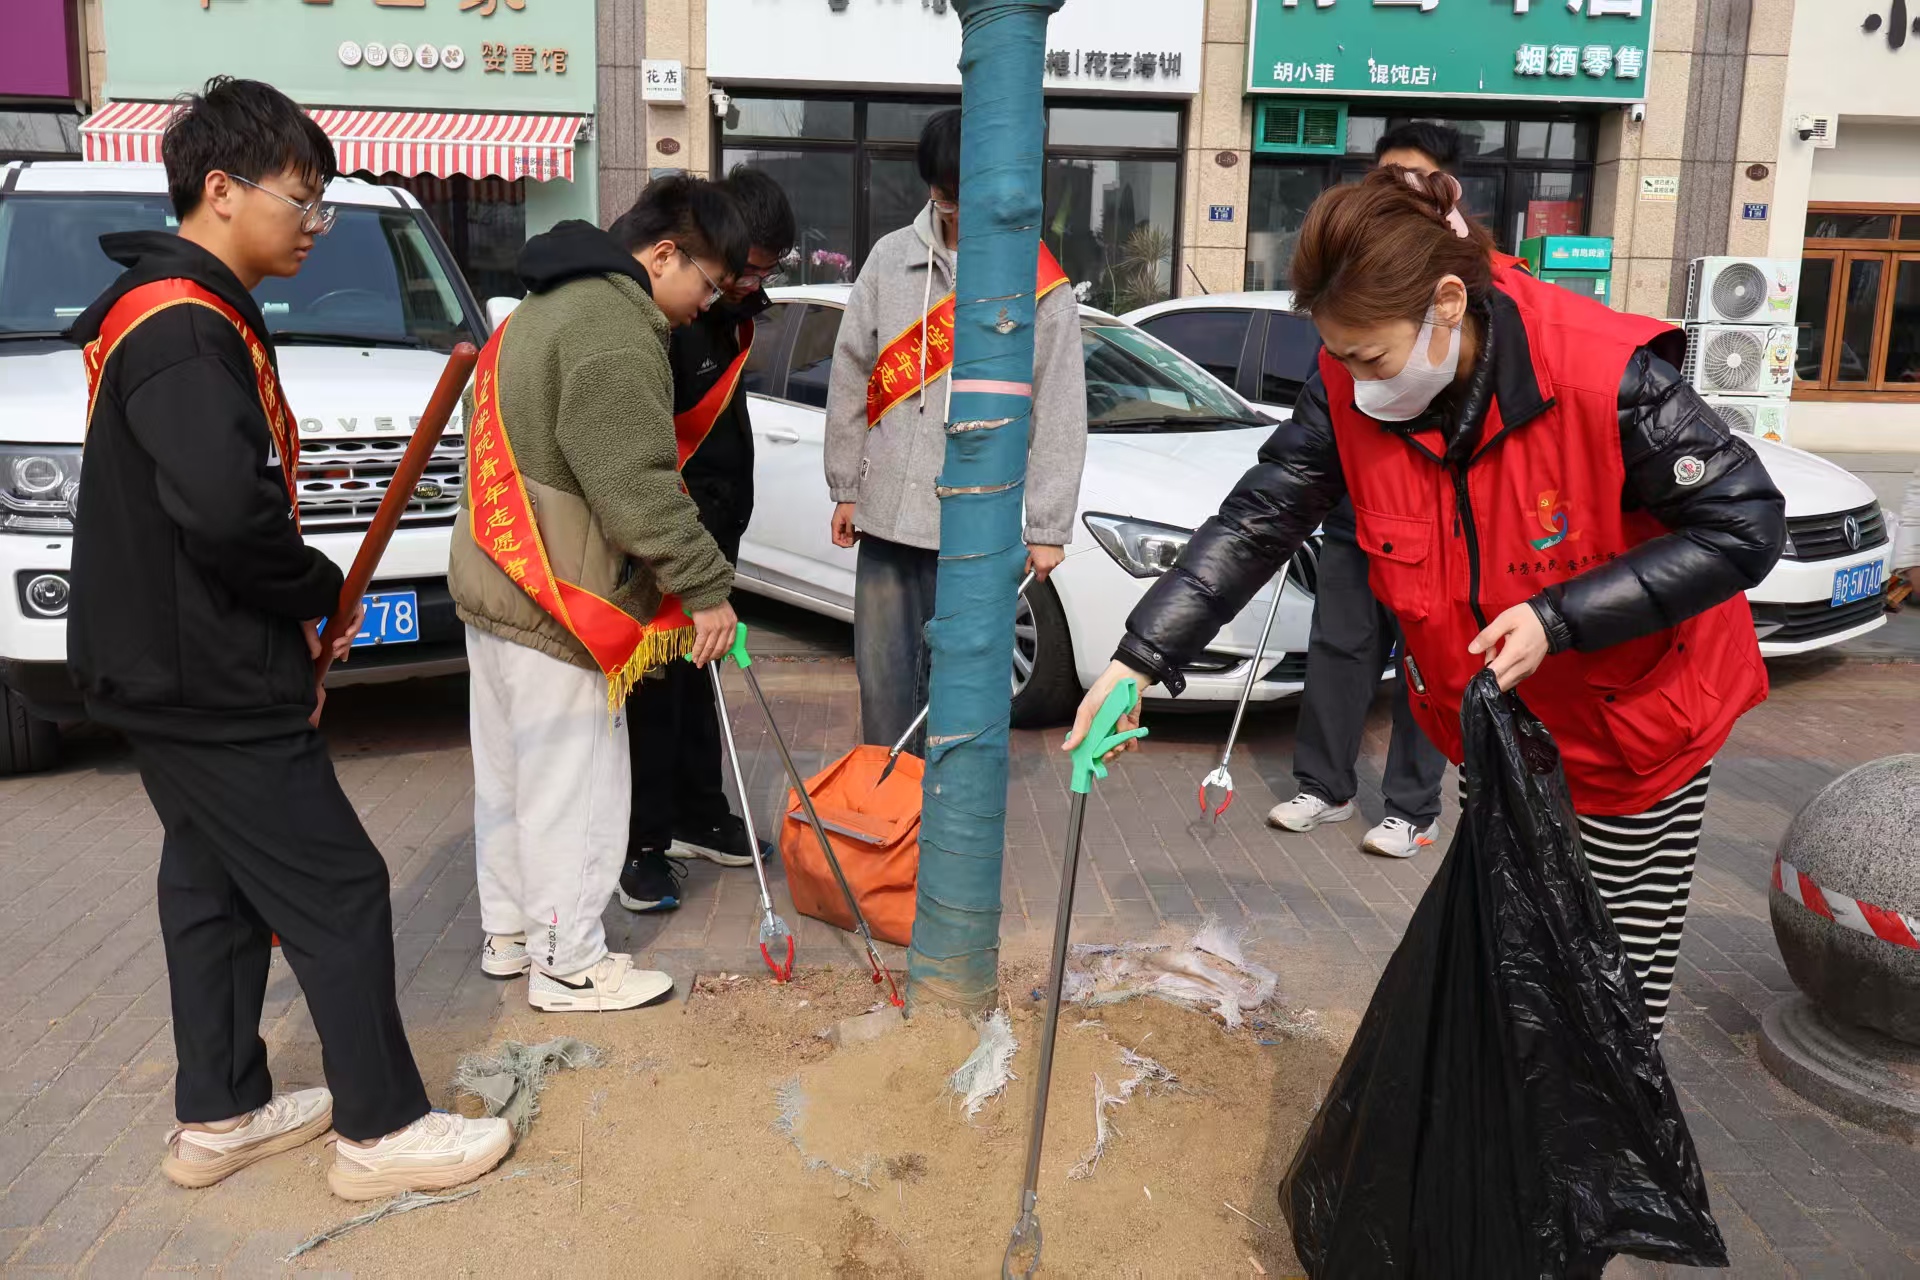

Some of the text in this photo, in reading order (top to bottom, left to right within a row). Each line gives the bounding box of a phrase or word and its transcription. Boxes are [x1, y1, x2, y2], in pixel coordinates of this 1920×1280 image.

[482, 42, 568, 74] 婴童馆
[1516, 43, 1643, 78] 烟酒零售
[646, 69, 677, 83] 花店
[1273, 62, 1335, 82] 胡小菲
[1369, 64, 1431, 85] 馄饨店
